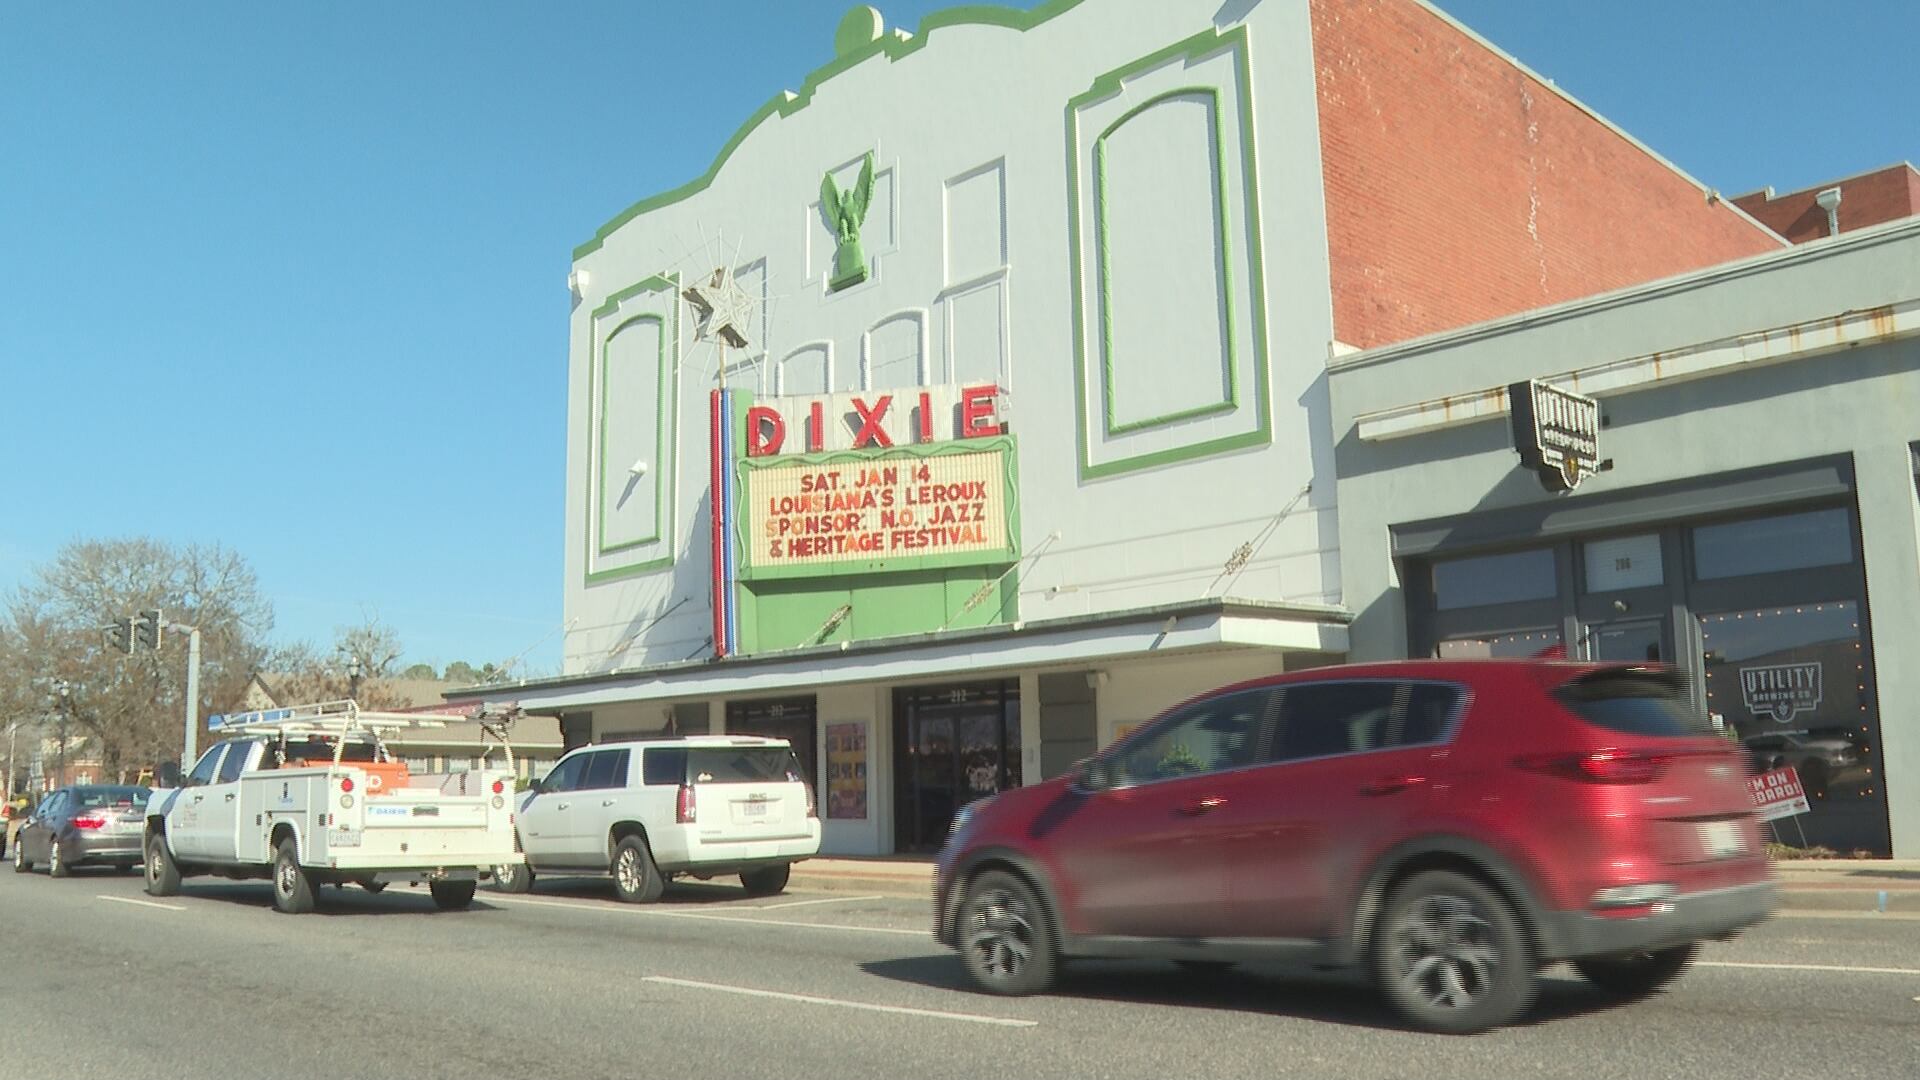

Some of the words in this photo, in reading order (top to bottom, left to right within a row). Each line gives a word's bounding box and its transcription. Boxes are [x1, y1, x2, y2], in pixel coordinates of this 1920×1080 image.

[747, 384, 1001, 457] DIXIE
[801, 472, 846, 493] SAT.
[855, 467, 898, 489] JAN
[911, 464, 931, 483] 14
[770, 488, 895, 516] LOUISIANA'S
[905, 481, 986, 506] LEROUX
[927, 502, 985, 525] JAZZ
[770, 540, 782, 558] &
[788, 532, 885, 557] HERITAGE
[891, 524, 988, 551] FESTIVAL
[1746, 667, 1815, 693] UTILITY
[1756, 782, 1800, 803] OARD!
[1767, 772, 1787, 787] ON
